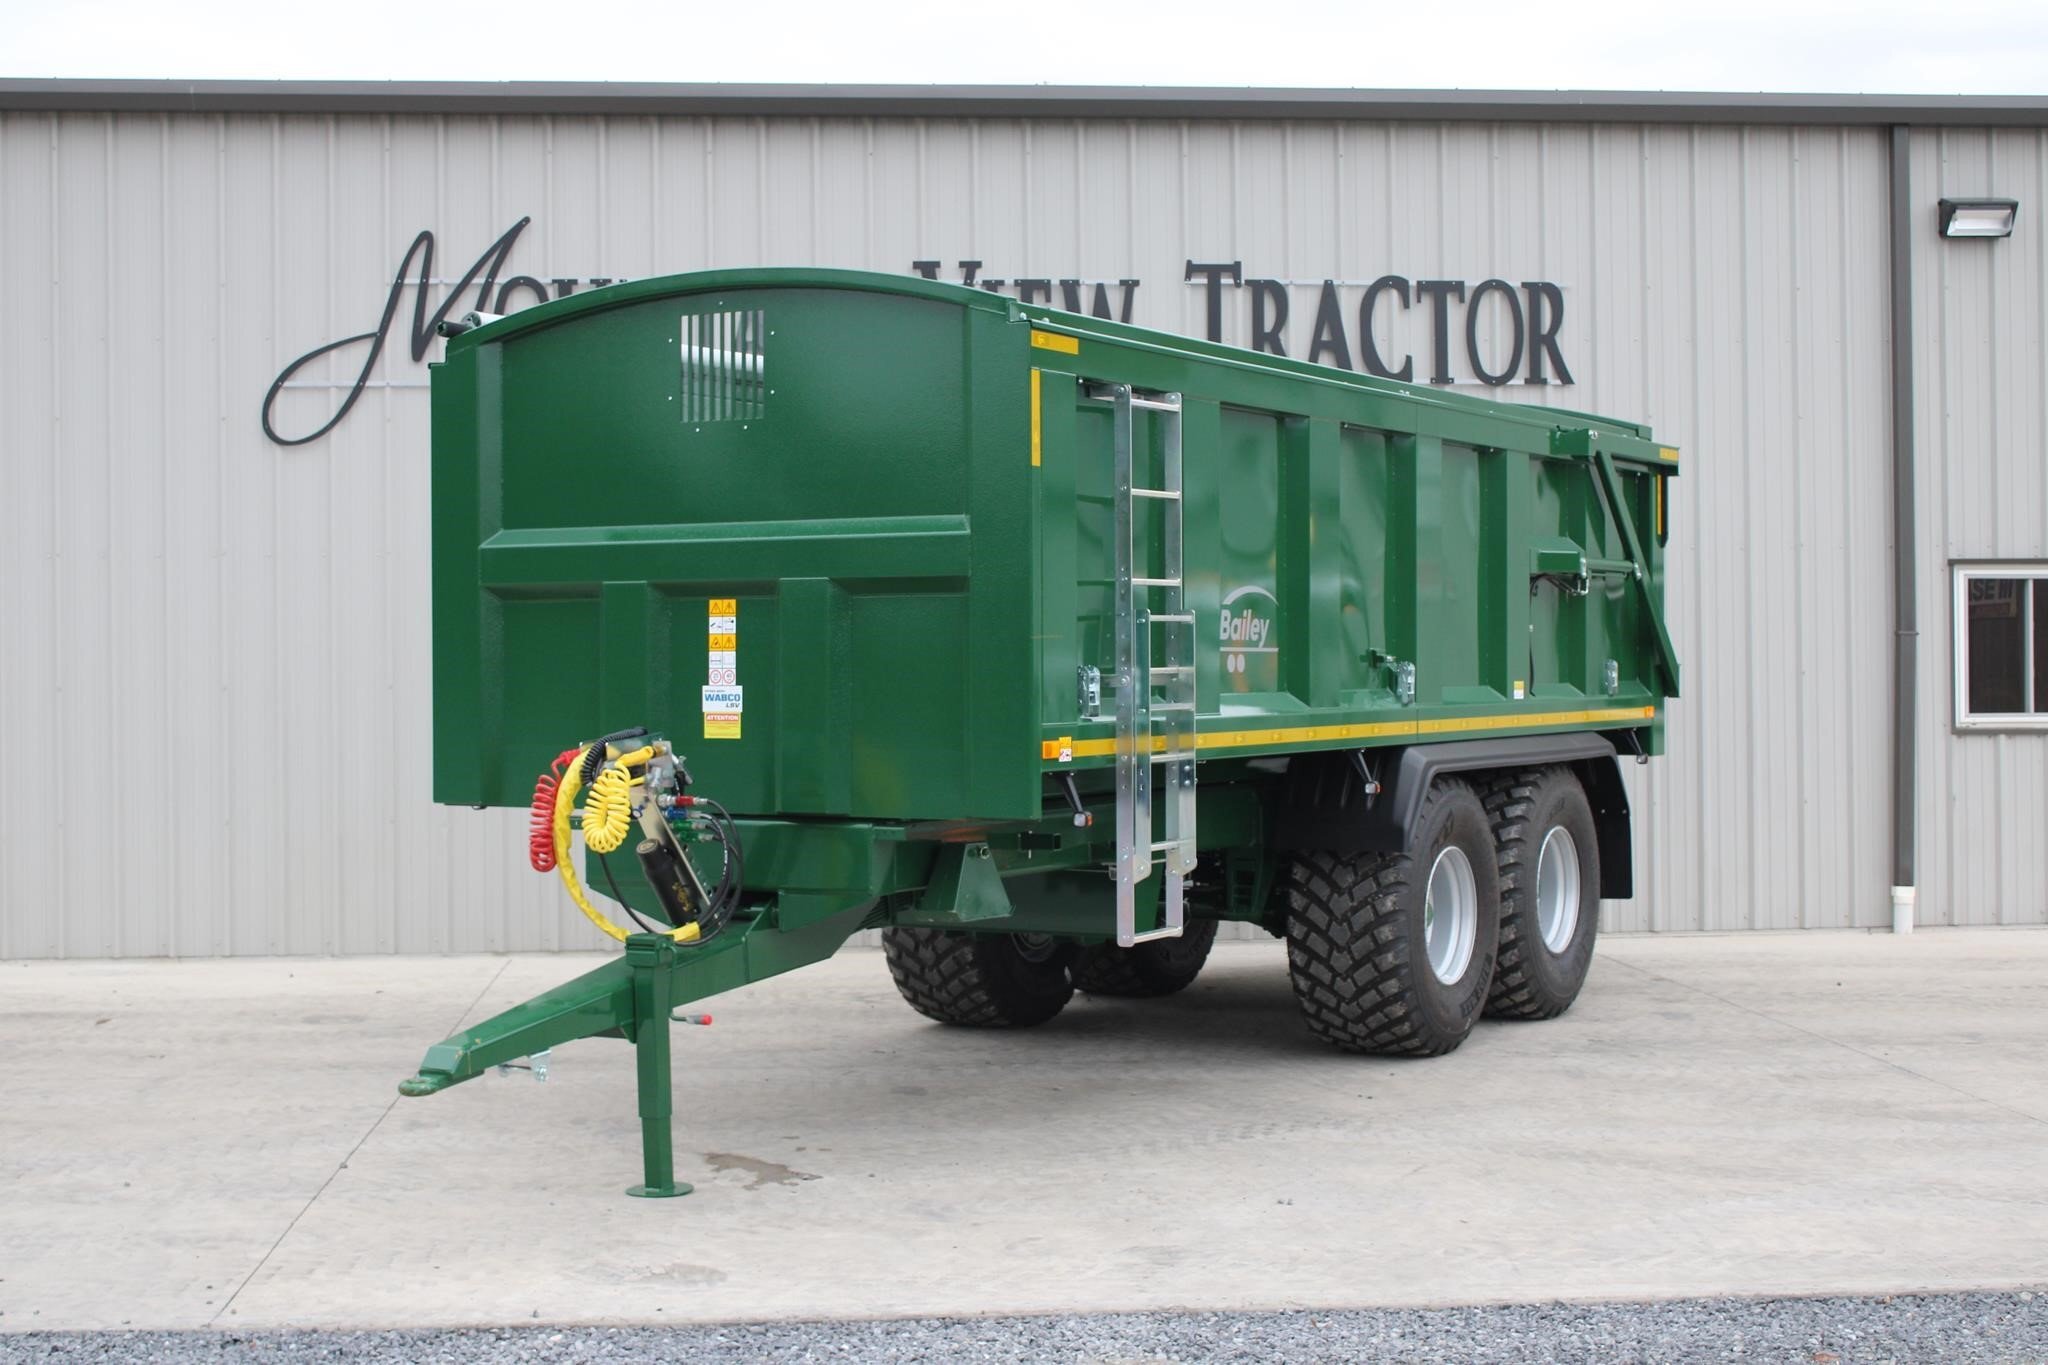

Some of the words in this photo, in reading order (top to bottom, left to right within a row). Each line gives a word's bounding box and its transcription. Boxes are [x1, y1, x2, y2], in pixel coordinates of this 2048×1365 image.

[1185, 259, 1575, 387] TRACTOR
[1220, 608, 1270, 648] Bailey
[704, 693, 741, 702] WABCO
